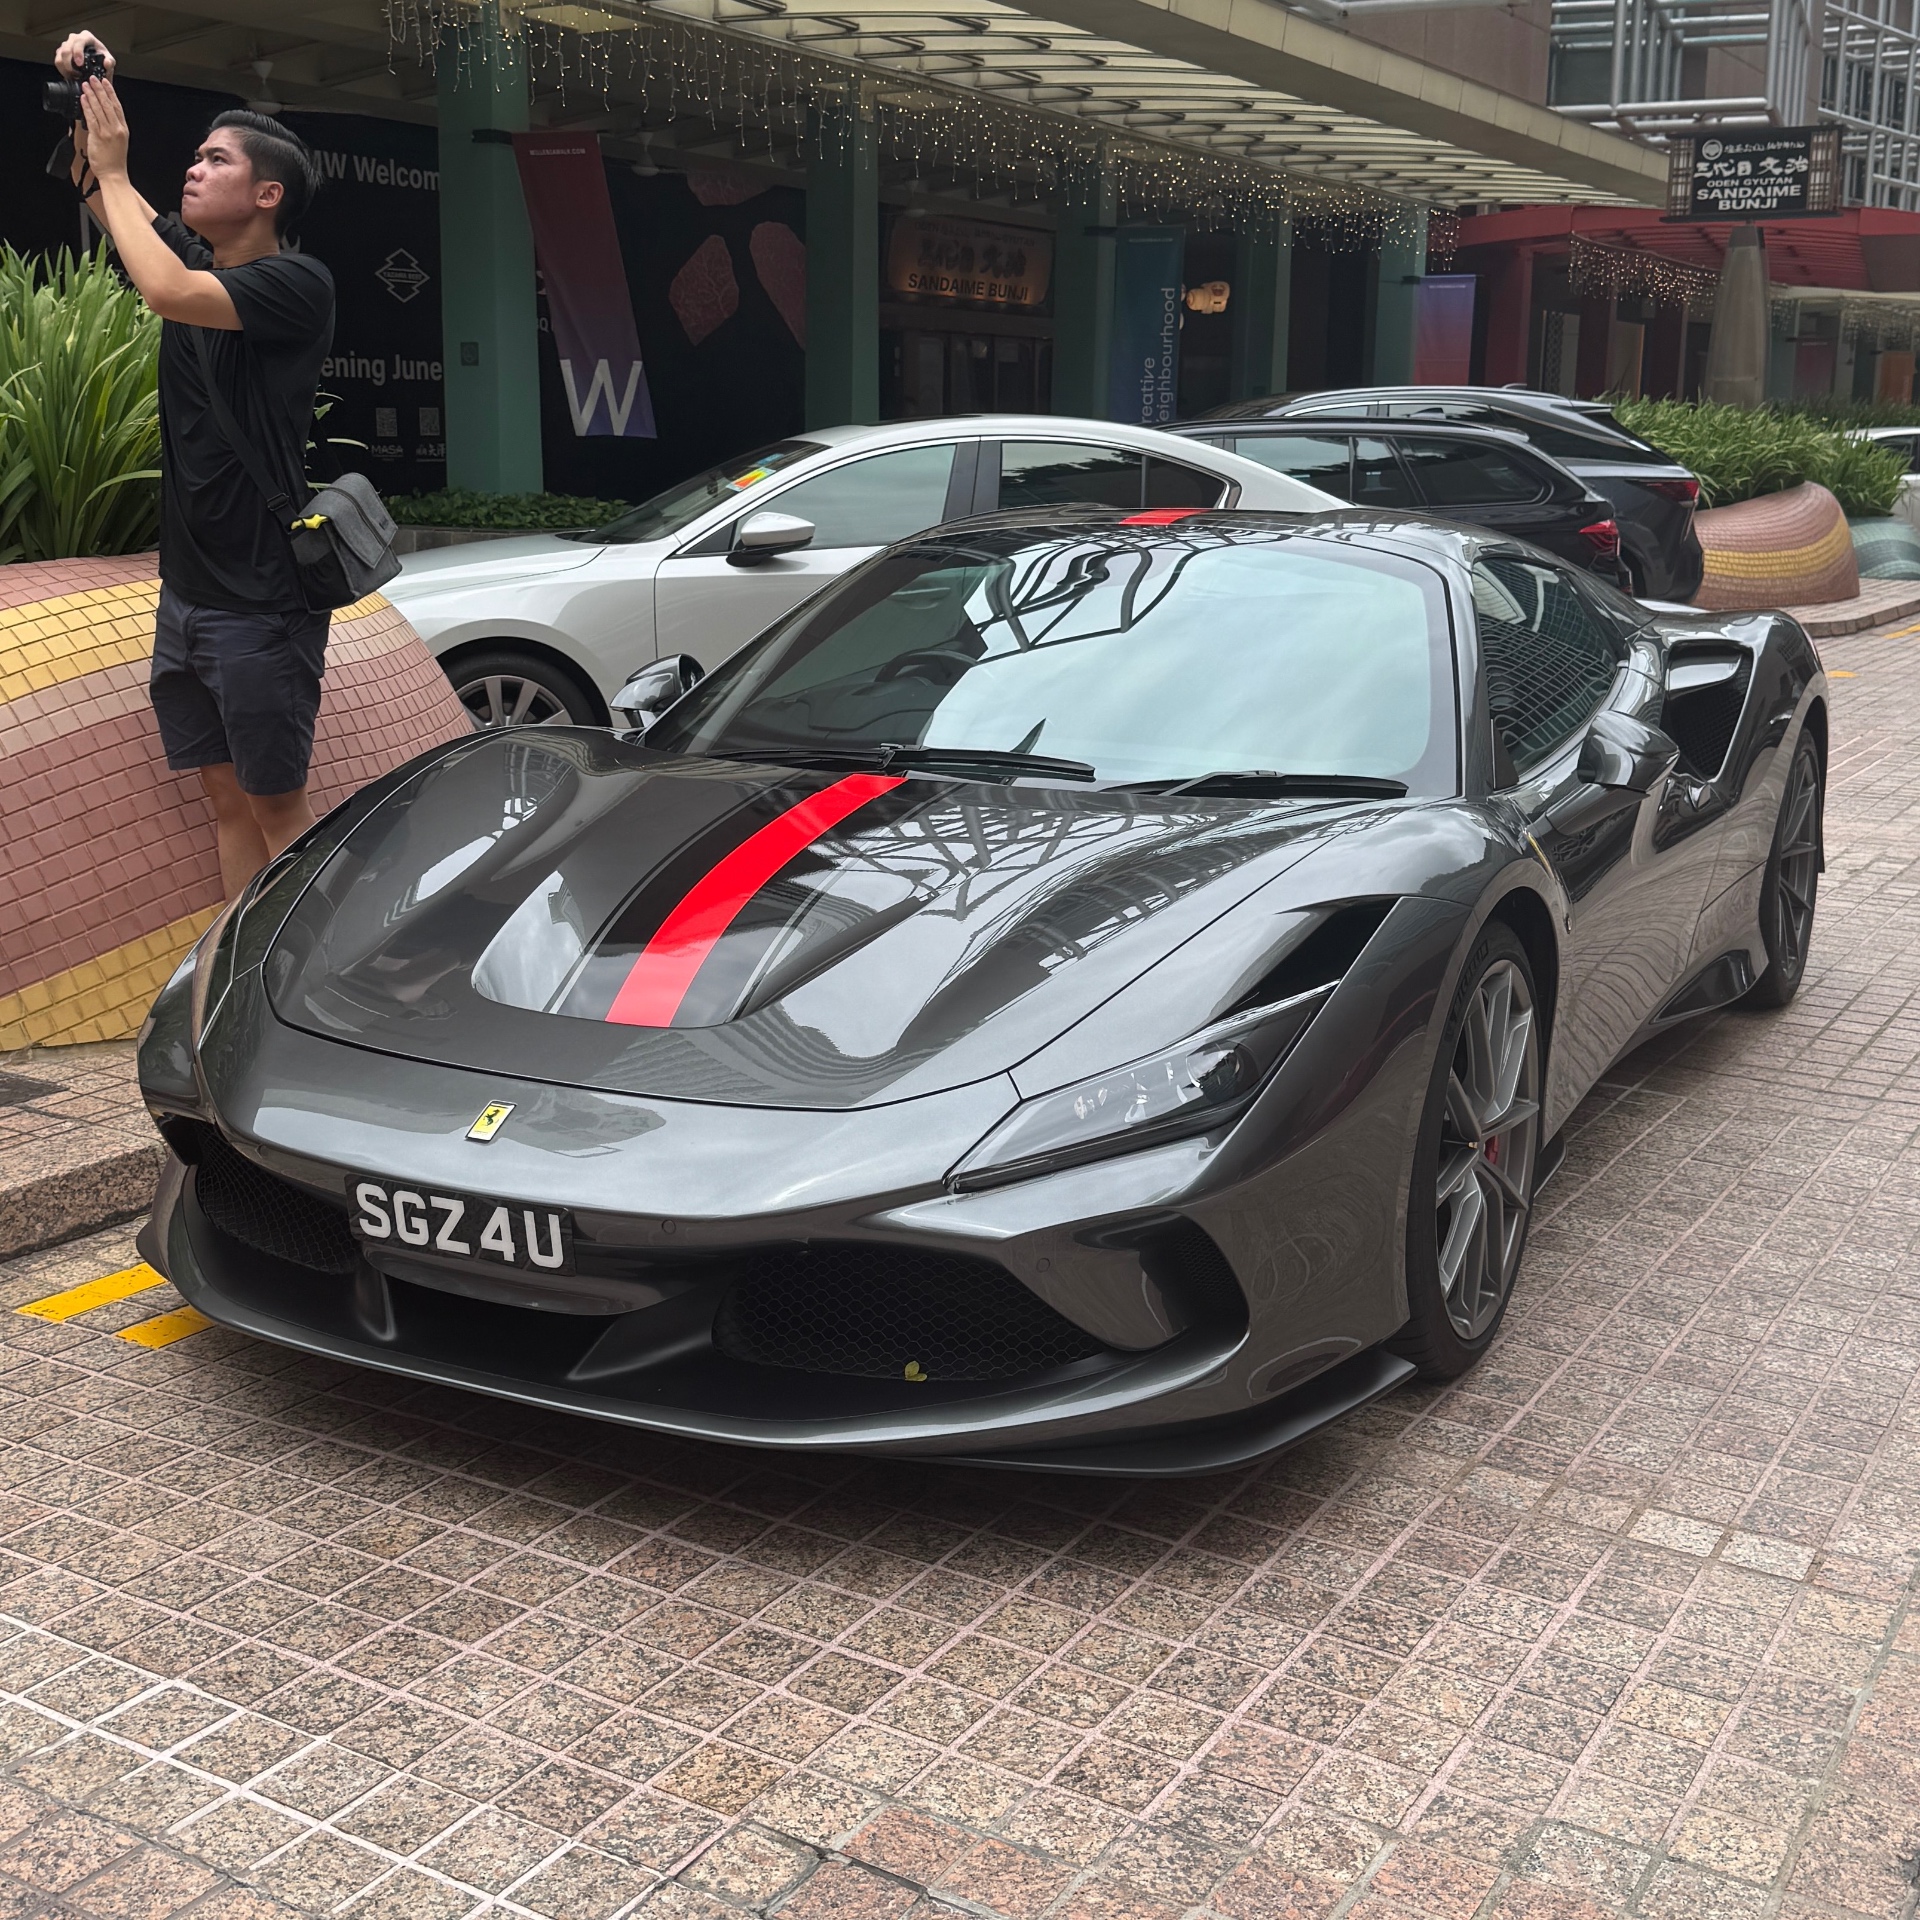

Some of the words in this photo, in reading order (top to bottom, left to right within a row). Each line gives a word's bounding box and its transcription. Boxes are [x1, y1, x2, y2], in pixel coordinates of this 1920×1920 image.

[1696, 184, 1802, 200] SANDAIME
[1706, 179, 1739, 188] ODEN
[1743, 177, 1793, 186] GYUTAN
[1718, 198, 1778, 211] BUNJI
[908, 273, 985, 296] SANDAIME
[988, 282, 1029, 301] BUNJI
[1156, 287, 1176, 423] eighbourhood
[392, 353, 443, 381] June
[560, 358, 643, 437] W
[371, 444, 404, 455] MASA
